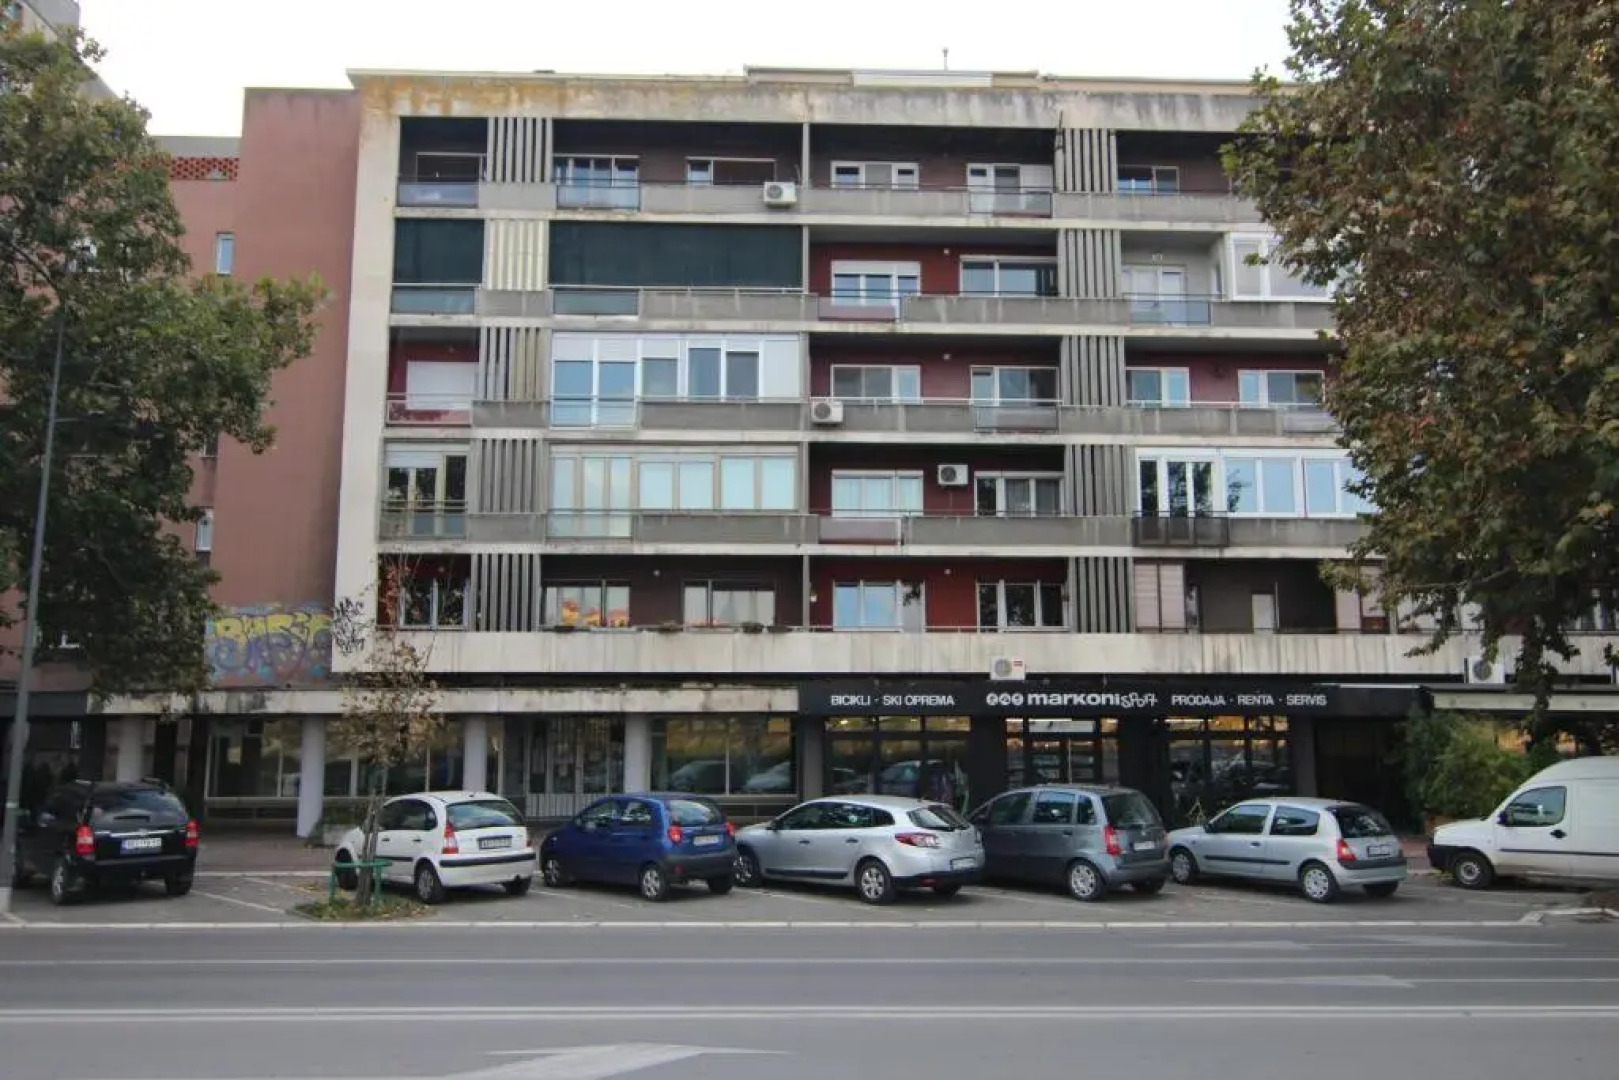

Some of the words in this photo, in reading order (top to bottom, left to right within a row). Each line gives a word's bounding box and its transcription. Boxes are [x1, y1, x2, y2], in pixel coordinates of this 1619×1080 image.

[831, 694, 871, 706] BICIKLI
[881, 694, 902, 706] SKI
[904, 694, 955, 706] OPREMA
[1172, 694, 1226, 706] PRODAJA
[1237, 694, 1275, 706] RENTA
[1286, 693, 1327, 706] SERVIS
